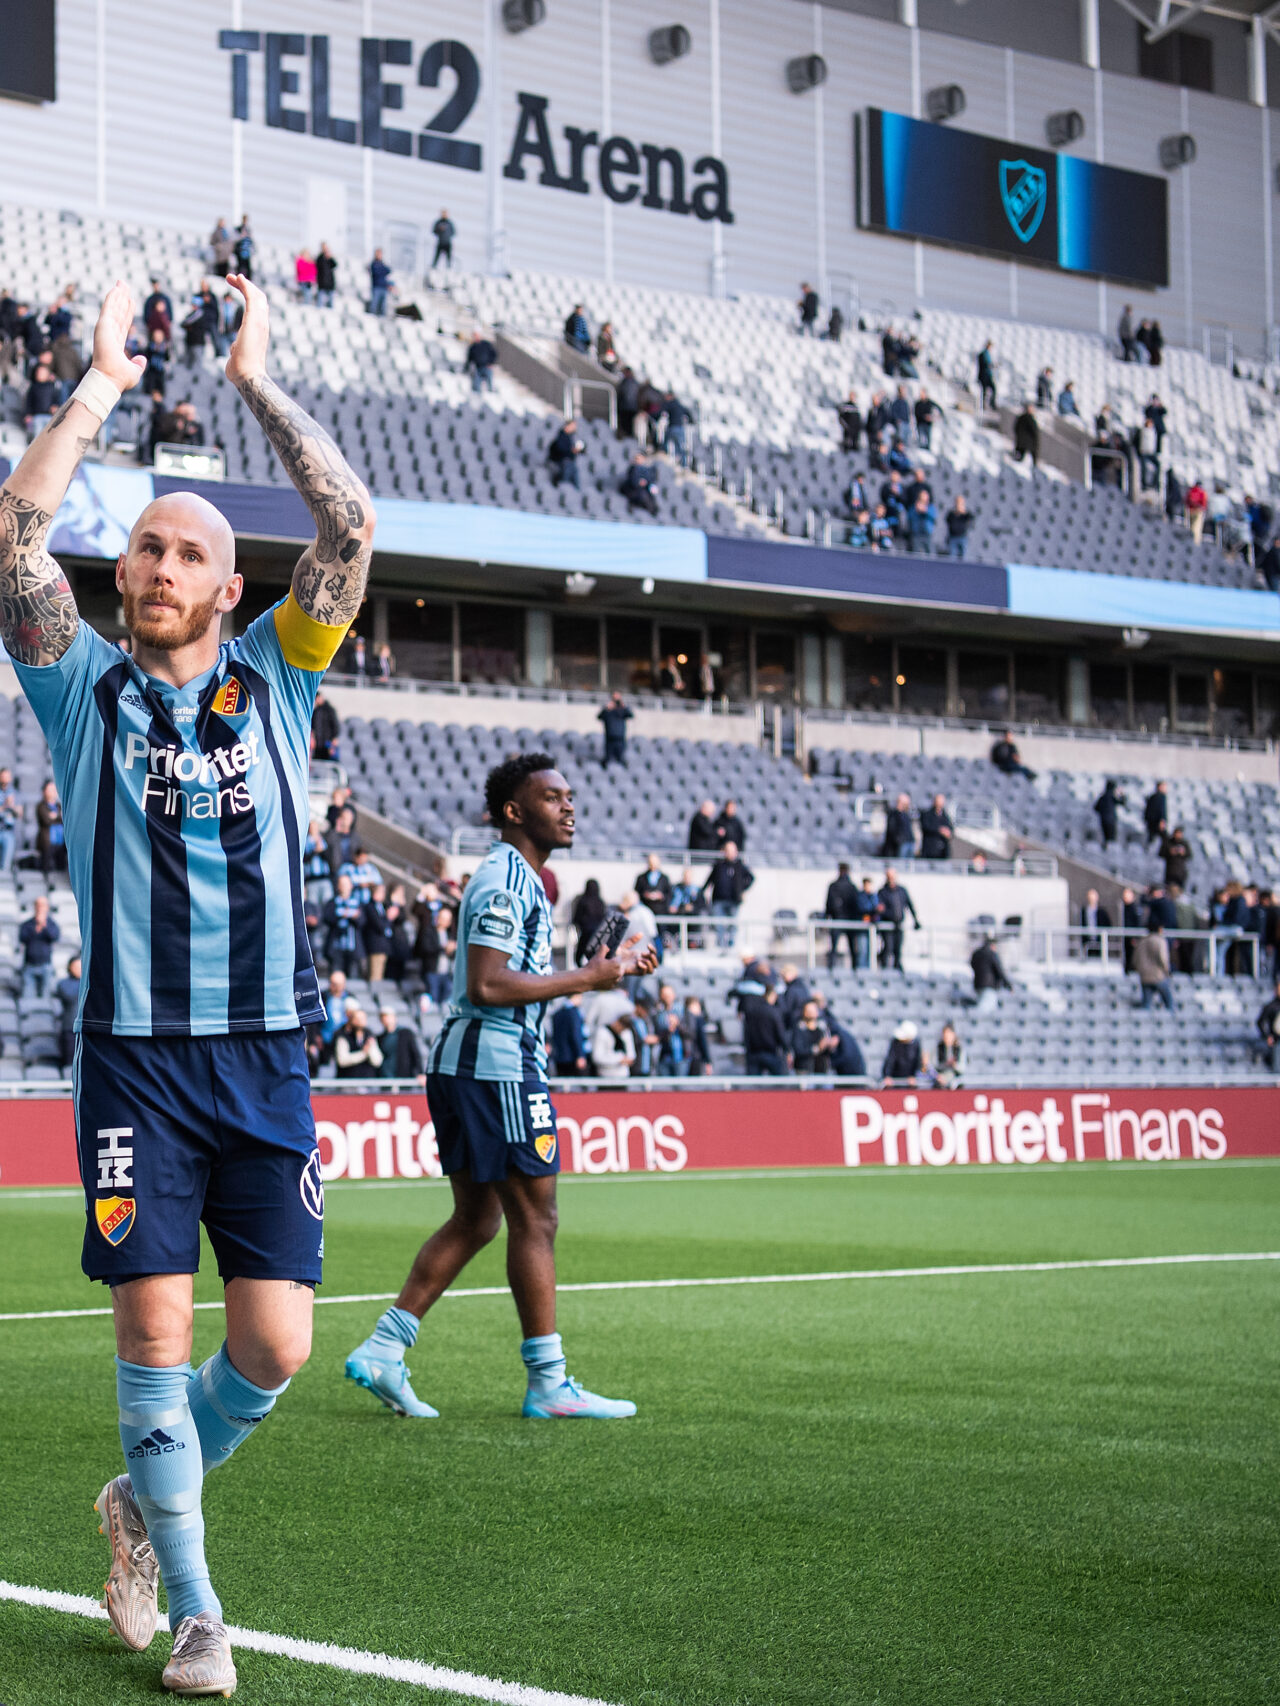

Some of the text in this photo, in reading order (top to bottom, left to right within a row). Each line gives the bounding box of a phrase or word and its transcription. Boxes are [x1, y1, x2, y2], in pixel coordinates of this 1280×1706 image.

[218, 30, 734, 224] TELE2 Arena
[120, 695, 153, 717] adidas
[124, 731, 260, 784] Prioritet
[141, 773, 254, 818] Finans
[558, 1114, 688, 1174] nans
[841, 1093, 1227, 1167] Prioritet Finans
[128, 1441, 186, 1459] adidas
